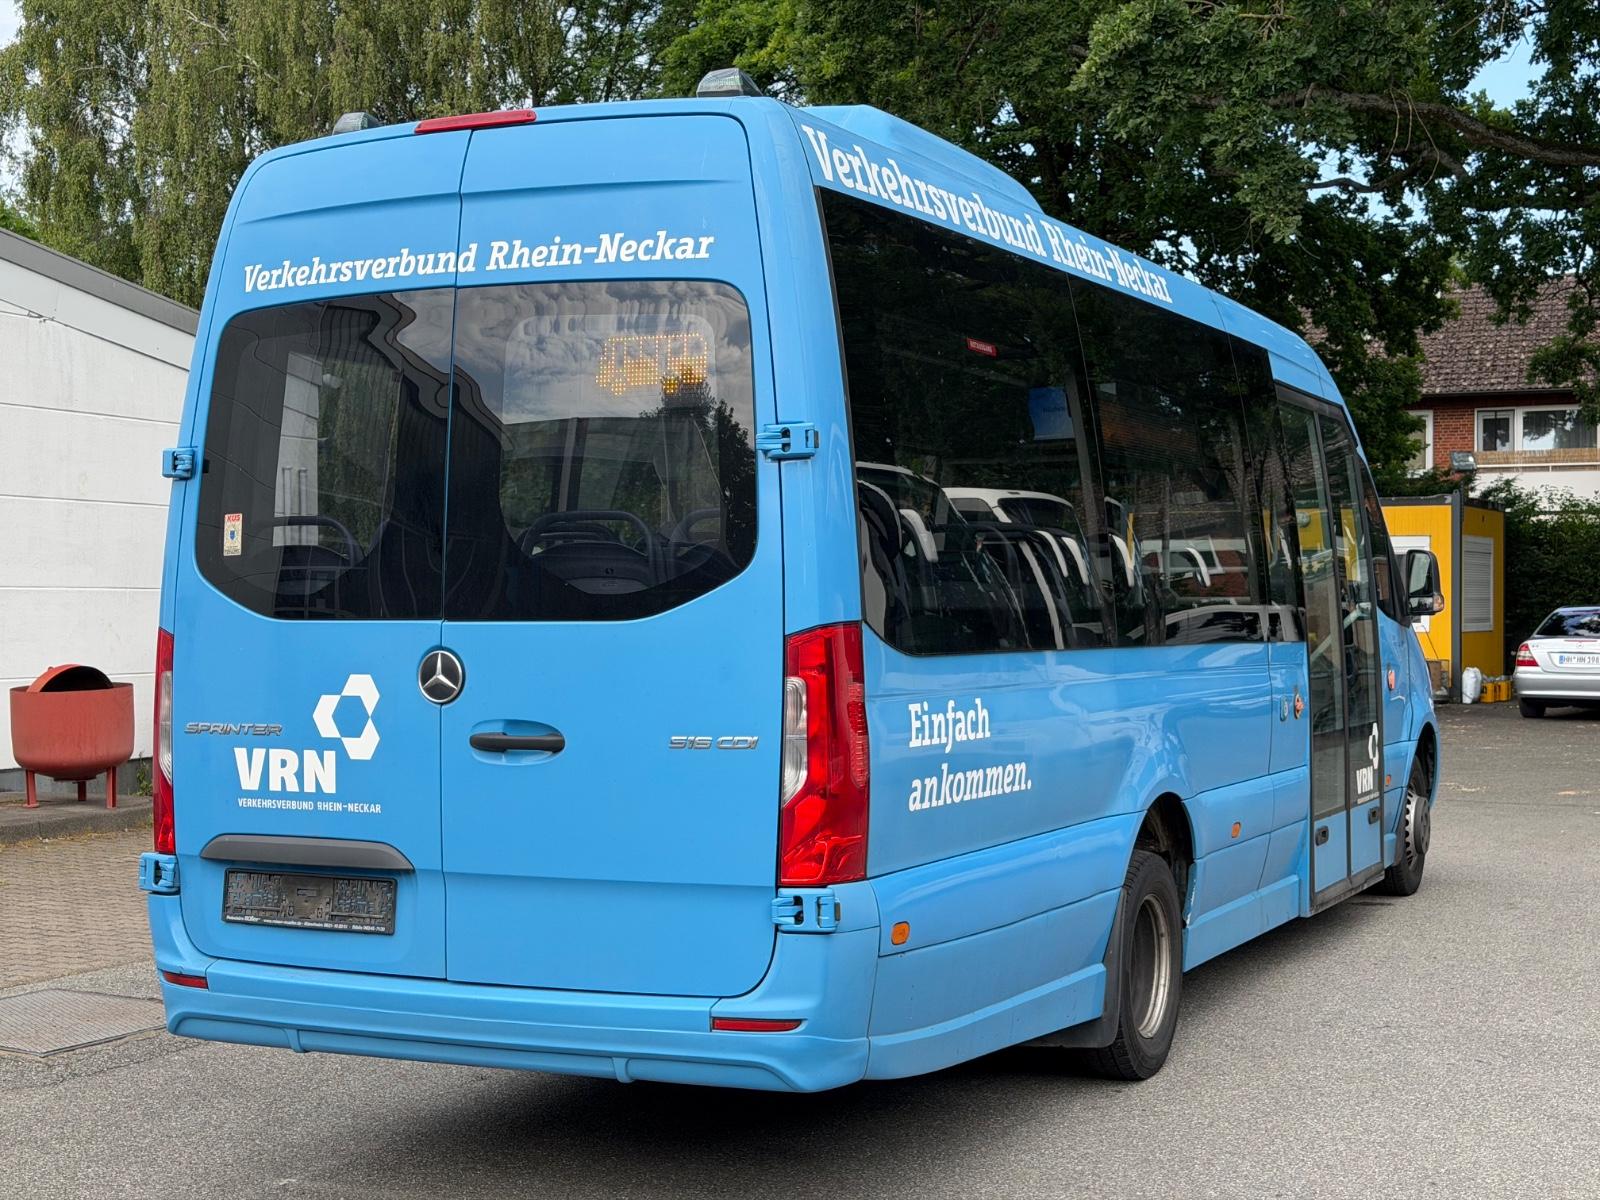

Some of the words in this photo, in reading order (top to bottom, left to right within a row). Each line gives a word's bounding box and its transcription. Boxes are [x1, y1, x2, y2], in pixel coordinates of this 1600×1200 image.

[801, 124, 1047, 257] Verkehrsverbund
[1039, 219, 1173, 304] Rhein-Neckar
[243, 242, 477, 293] Verkehrsverbund
[485, 229, 715, 272] Rhein-Neckar
[184, 722, 283, 736] SPRINTER
[716, 735, 759, 750] CDI
[908, 697, 991, 754] Einfach
[233, 747, 337, 794] VRN
[908, 761, 1032, 812] ankommen.
[1356, 766, 1374, 795] VRN
[237, 797, 314, 811] VERKEHRSVERBUND
[317, 801, 382, 814] RHEIN-NECKAR
